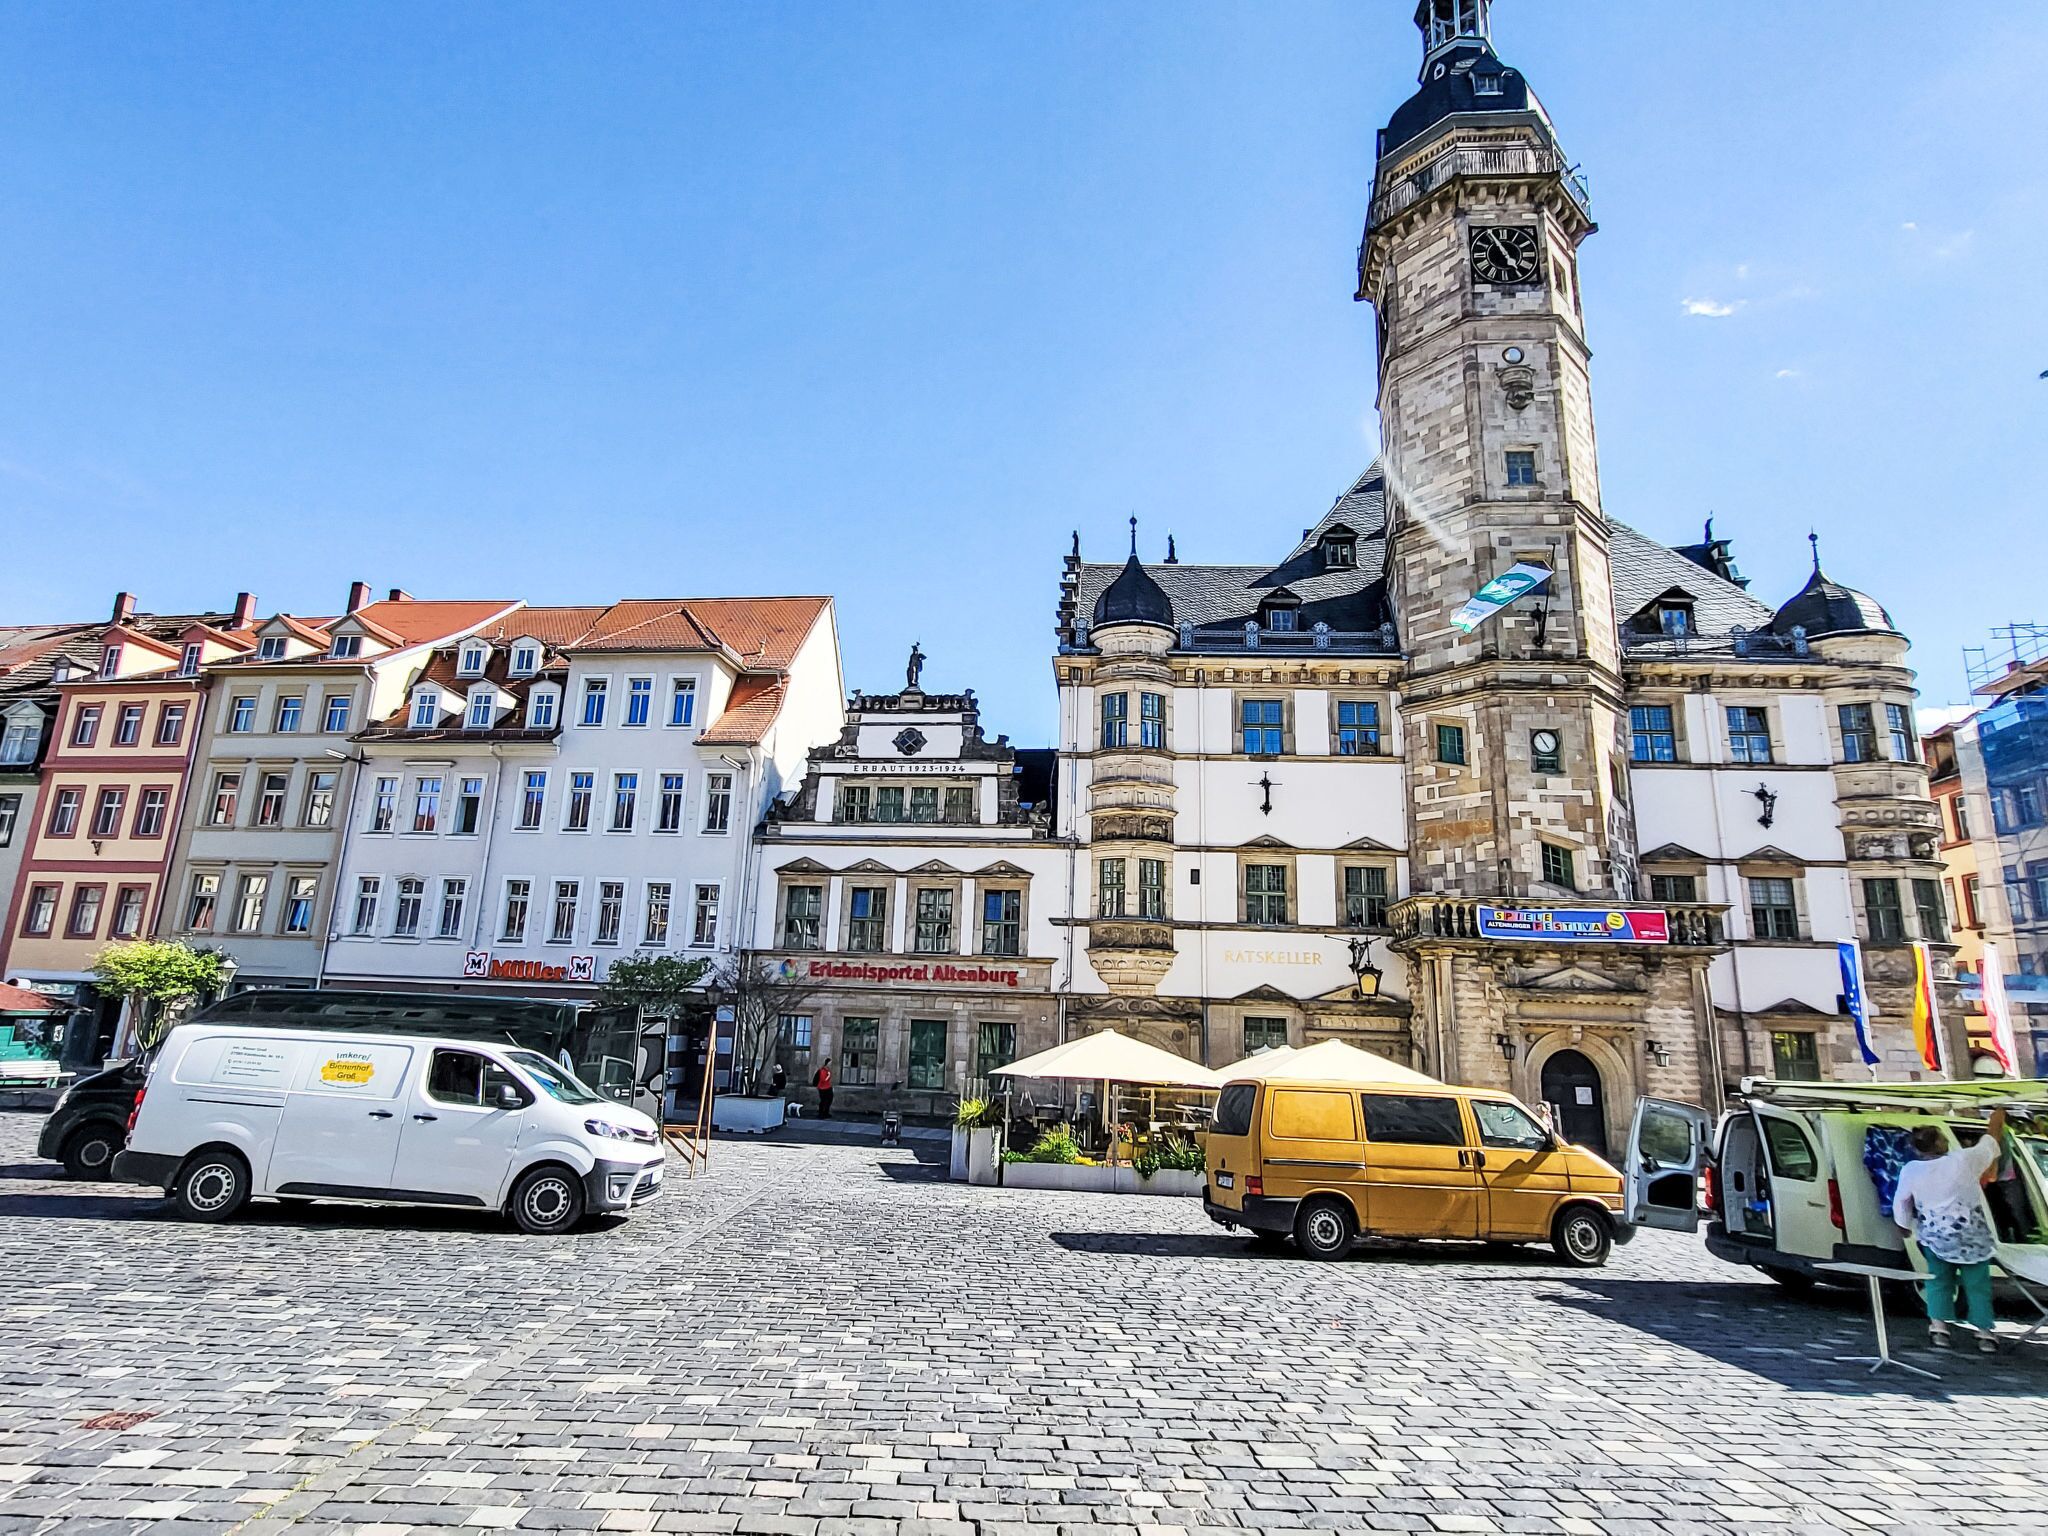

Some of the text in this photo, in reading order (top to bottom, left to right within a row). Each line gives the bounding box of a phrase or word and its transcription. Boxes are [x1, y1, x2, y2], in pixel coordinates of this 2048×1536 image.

[1495, 912, 1551, 921] SPIELE
[1224, 950, 1322, 965] RATSKELLER
[490, 959, 567, 980] Müller
[808, 960, 1019, 986] Erlebnisportal Altenburg
